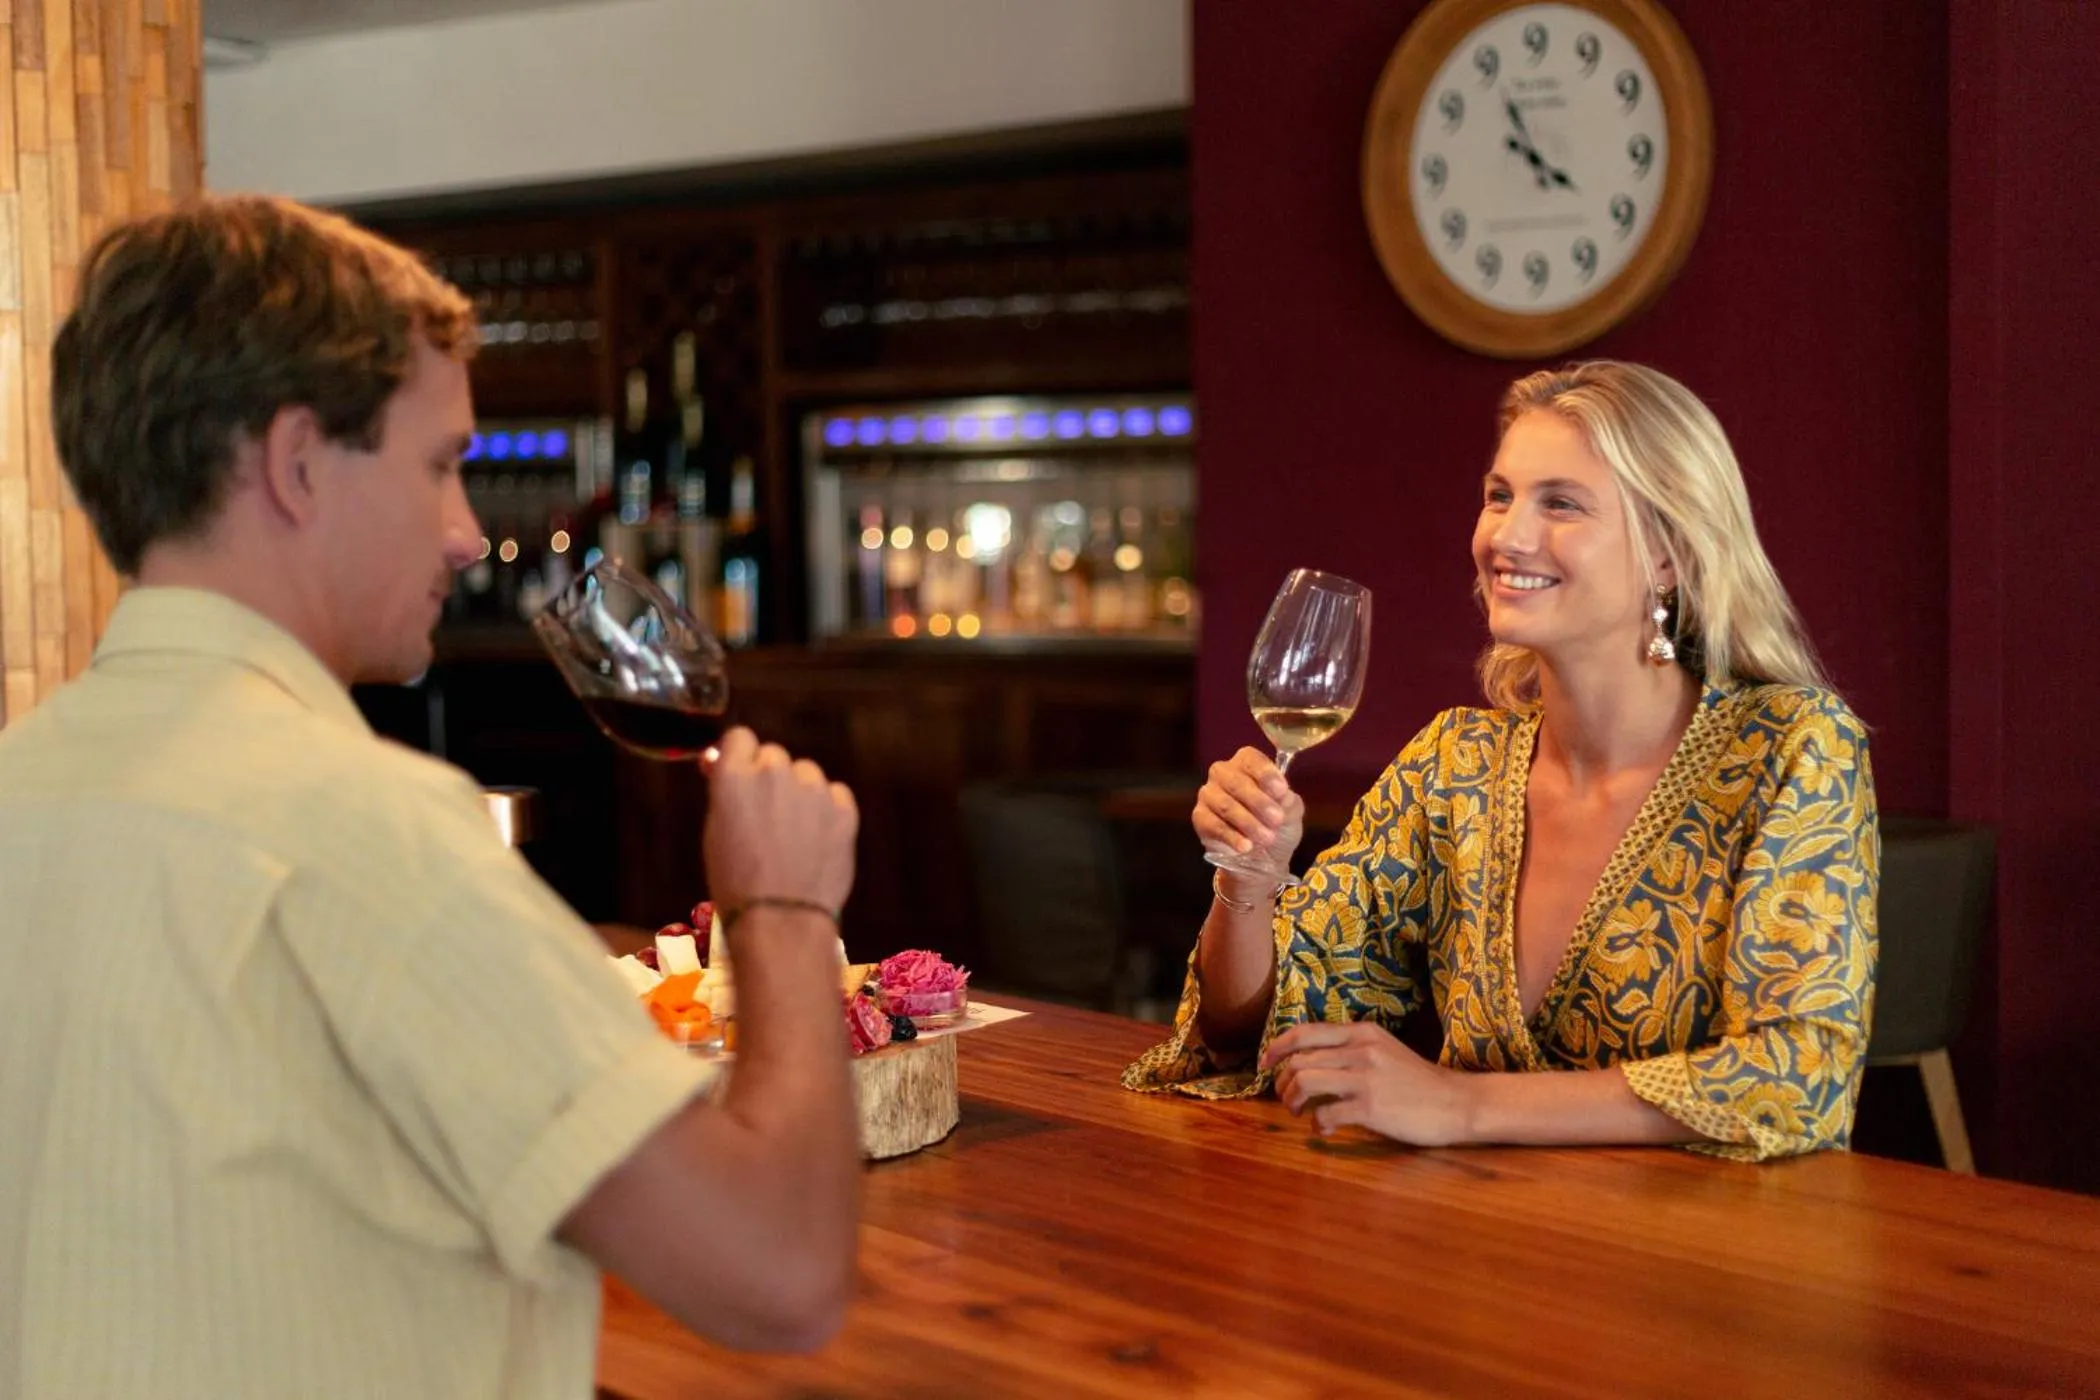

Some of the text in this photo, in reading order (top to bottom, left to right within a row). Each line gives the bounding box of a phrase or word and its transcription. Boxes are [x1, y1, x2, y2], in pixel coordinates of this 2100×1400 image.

[1523, 21, 1549, 66] 9
[1574, 32, 1602, 78] 9
[1473, 45, 1500, 90] 9
[1439, 89, 1465, 136] 9
[1614, 69, 1642, 114] 9
[1422, 153, 1448, 199] 9
[1627, 133, 1654, 180] 9
[1441, 207, 1467, 252] 9
[1609, 193, 1636, 240] 9
[1475, 244, 1502, 291] 9
[1523, 251, 1549, 297] 9
[1571, 236, 1598, 284] 9
